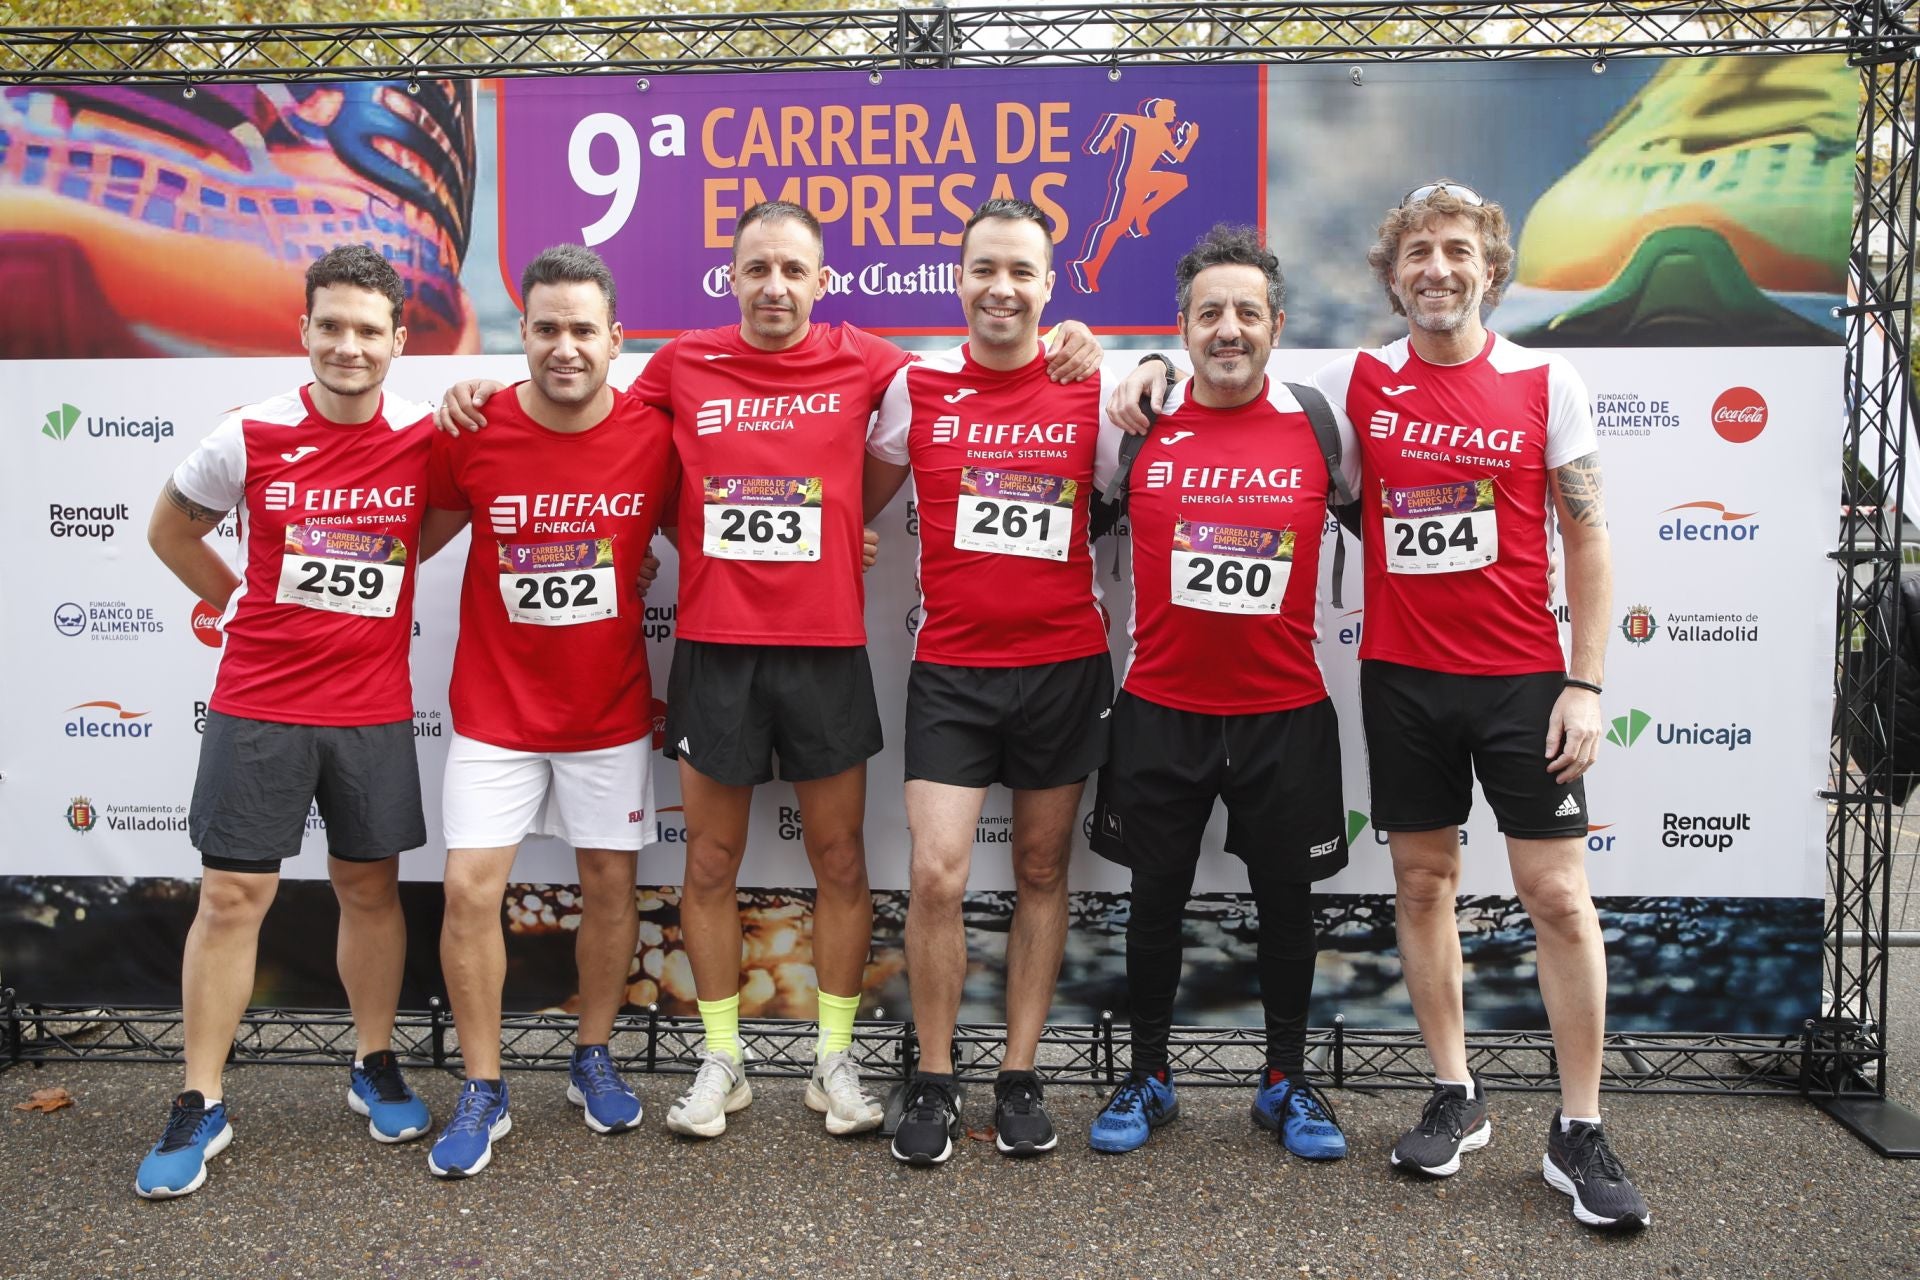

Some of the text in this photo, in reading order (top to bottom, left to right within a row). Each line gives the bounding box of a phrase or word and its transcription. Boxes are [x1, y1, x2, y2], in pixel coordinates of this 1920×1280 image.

[702, 103, 977, 168] CARRERA
[996, 102, 1070, 164] DE
[859, 261, 956, 296] Castill
[1597, 393, 1639, 401] FUNDACIÓN
[737, 393, 840, 418] EIFFAGE
[1597, 401, 1669, 414] BANCO DE
[1597, 415, 1680, 428] ALIMENTOS
[1714, 406, 1766, 422] Coca-Cola
[87, 416, 174, 443] Unicaja
[737, 418, 794, 432] ENERGÍA
[967, 423, 1078, 444] EIFFAGE
[1402, 421, 1526, 453] EIFFAGE
[1608, 429, 1650, 437] VALLADOLID
[967, 448, 1068, 459] ENERGÍA SISTEMAS
[1401, 449, 1511, 468] ENERGÍA SISTEMAS
[742, 479, 774, 487] CARRERA
[776, 479, 786, 487] DE
[1000, 472, 1032, 483] CARRERA
[1181, 468, 1303, 489] EIFFAGE
[742, 487, 785, 496] EMPRESAS
[999, 481, 1042, 493] EMPRESAS
[1406, 488, 1440, 499] CARRERA
[1442, 487, 1453, 495] DE
[304, 485, 416, 510] EIFFAGE
[1181, 494, 1293, 504] ENERGÍA SISTEMAS
[1407, 495, 1454, 508] EMPRESAS
[50, 504, 129, 520] Renault
[533, 493, 646, 518] EIFFAGE
[305, 514, 407, 526] ENERGÍA SISTEMAS
[534, 519, 595, 534] ENERGÍA
[721, 508, 802, 543] 263
[972, 501, 1051, 541] 261
[50, 521, 114, 542] Group
[327, 531, 360, 542] CARRERA
[361, 535, 371, 543] DE
[1214, 527, 1248, 538] CARRERA
[1394, 517, 1478, 556] 264
[1659, 519, 1760, 541] elecnor
[326, 540, 370, 552] EMPRESAS
[1213, 535, 1258, 548] EMPRESAS
[531, 545, 564, 555] CARRERA
[565, 544, 576, 552] DE
[532, 551, 576, 563] EMPRESAS
[296, 561, 384, 600] 259
[1186, 557, 1272, 597] 260
[515, 574, 598, 609] 262
[89, 600, 126, 608] FUNDACIÓN
[90, 608, 154, 620] BANCO DE
[194, 613, 223, 629] Coca-
[1667, 613, 1759, 624] Ayuntamiento de
[91, 621, 164, 633] ALIMENTOS
[1667, 626, 1758, 641] Valladolid
[429, 710, 441, 718] de
[65, 716, 152, 738] elecnor
[1656, 723, 1752, 751] Unicaja
[106, 803, 187, 814] Ayuntamiento de
[106, 816, 188, 831] Valladolid
[1663, 813, 1750, 831] Renault
[1662, 831, 1733, 852] Group
